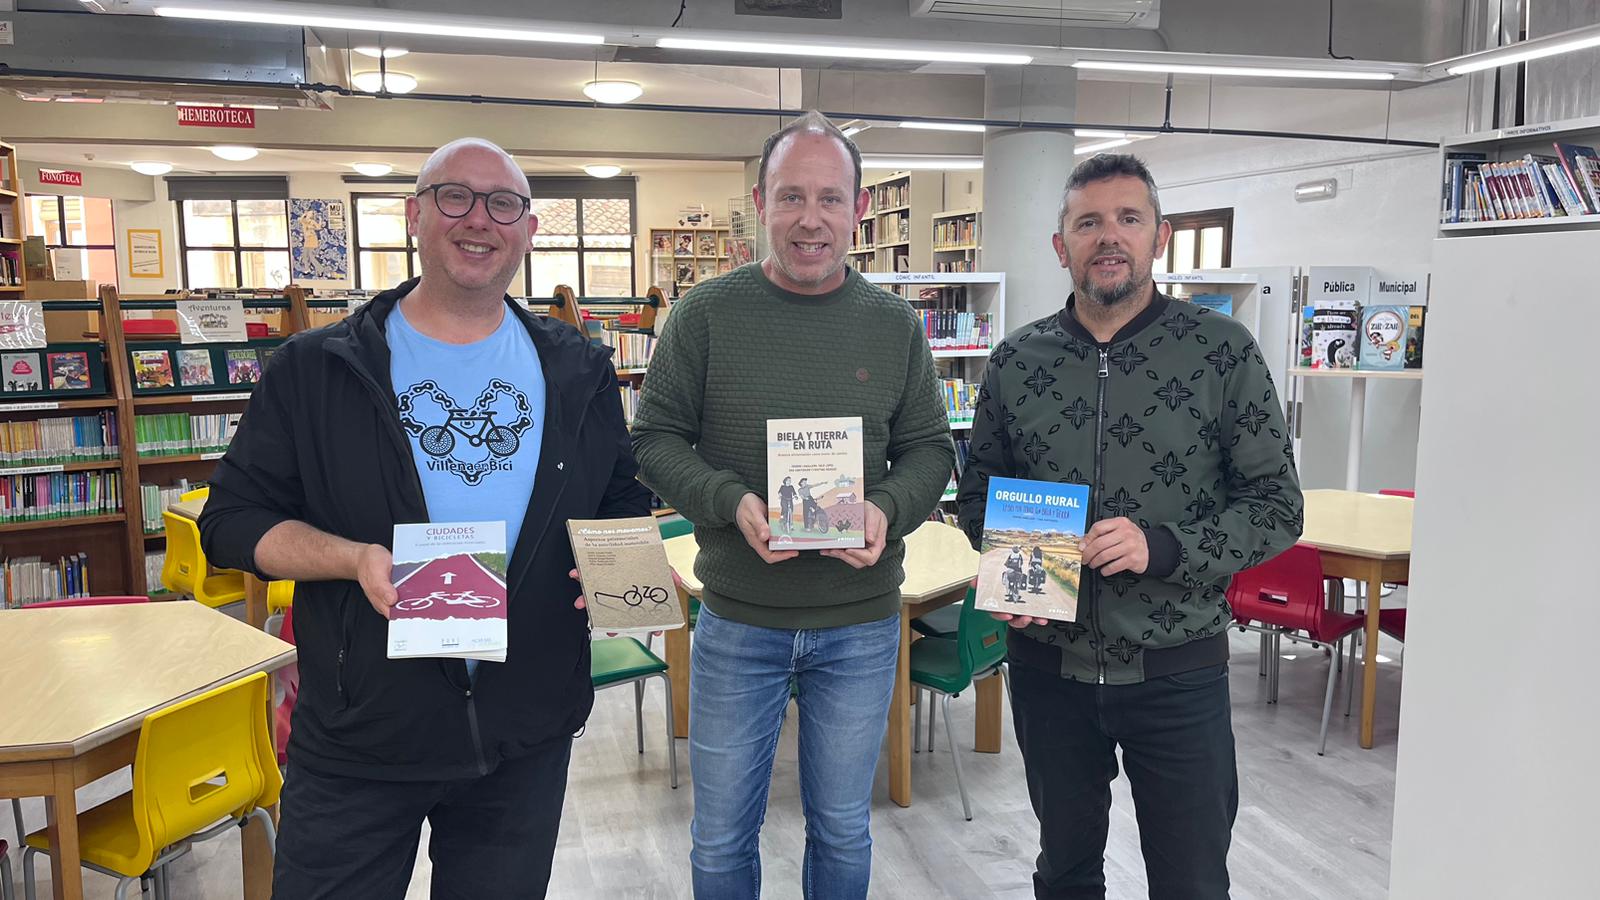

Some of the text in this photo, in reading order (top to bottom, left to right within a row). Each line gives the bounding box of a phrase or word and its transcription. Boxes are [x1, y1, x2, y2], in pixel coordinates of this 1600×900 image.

[180, 108, 252, 124] HEMEROTECA
[42, 172, 80, 184] FONOTECA
[1323, 281, 1355, 293] Pública
[1379, 281, 1417, 294] Municipal
[188, 304, 232, 312] Aventuras
[777, 430, 848, 441] BIELA Y TIERRA
[793, 440, 833, 450] EN RUTA
[995, 490, 1080, 508] ORGULLO RURAL
[426, 526, 475, 535] CIUDADES
